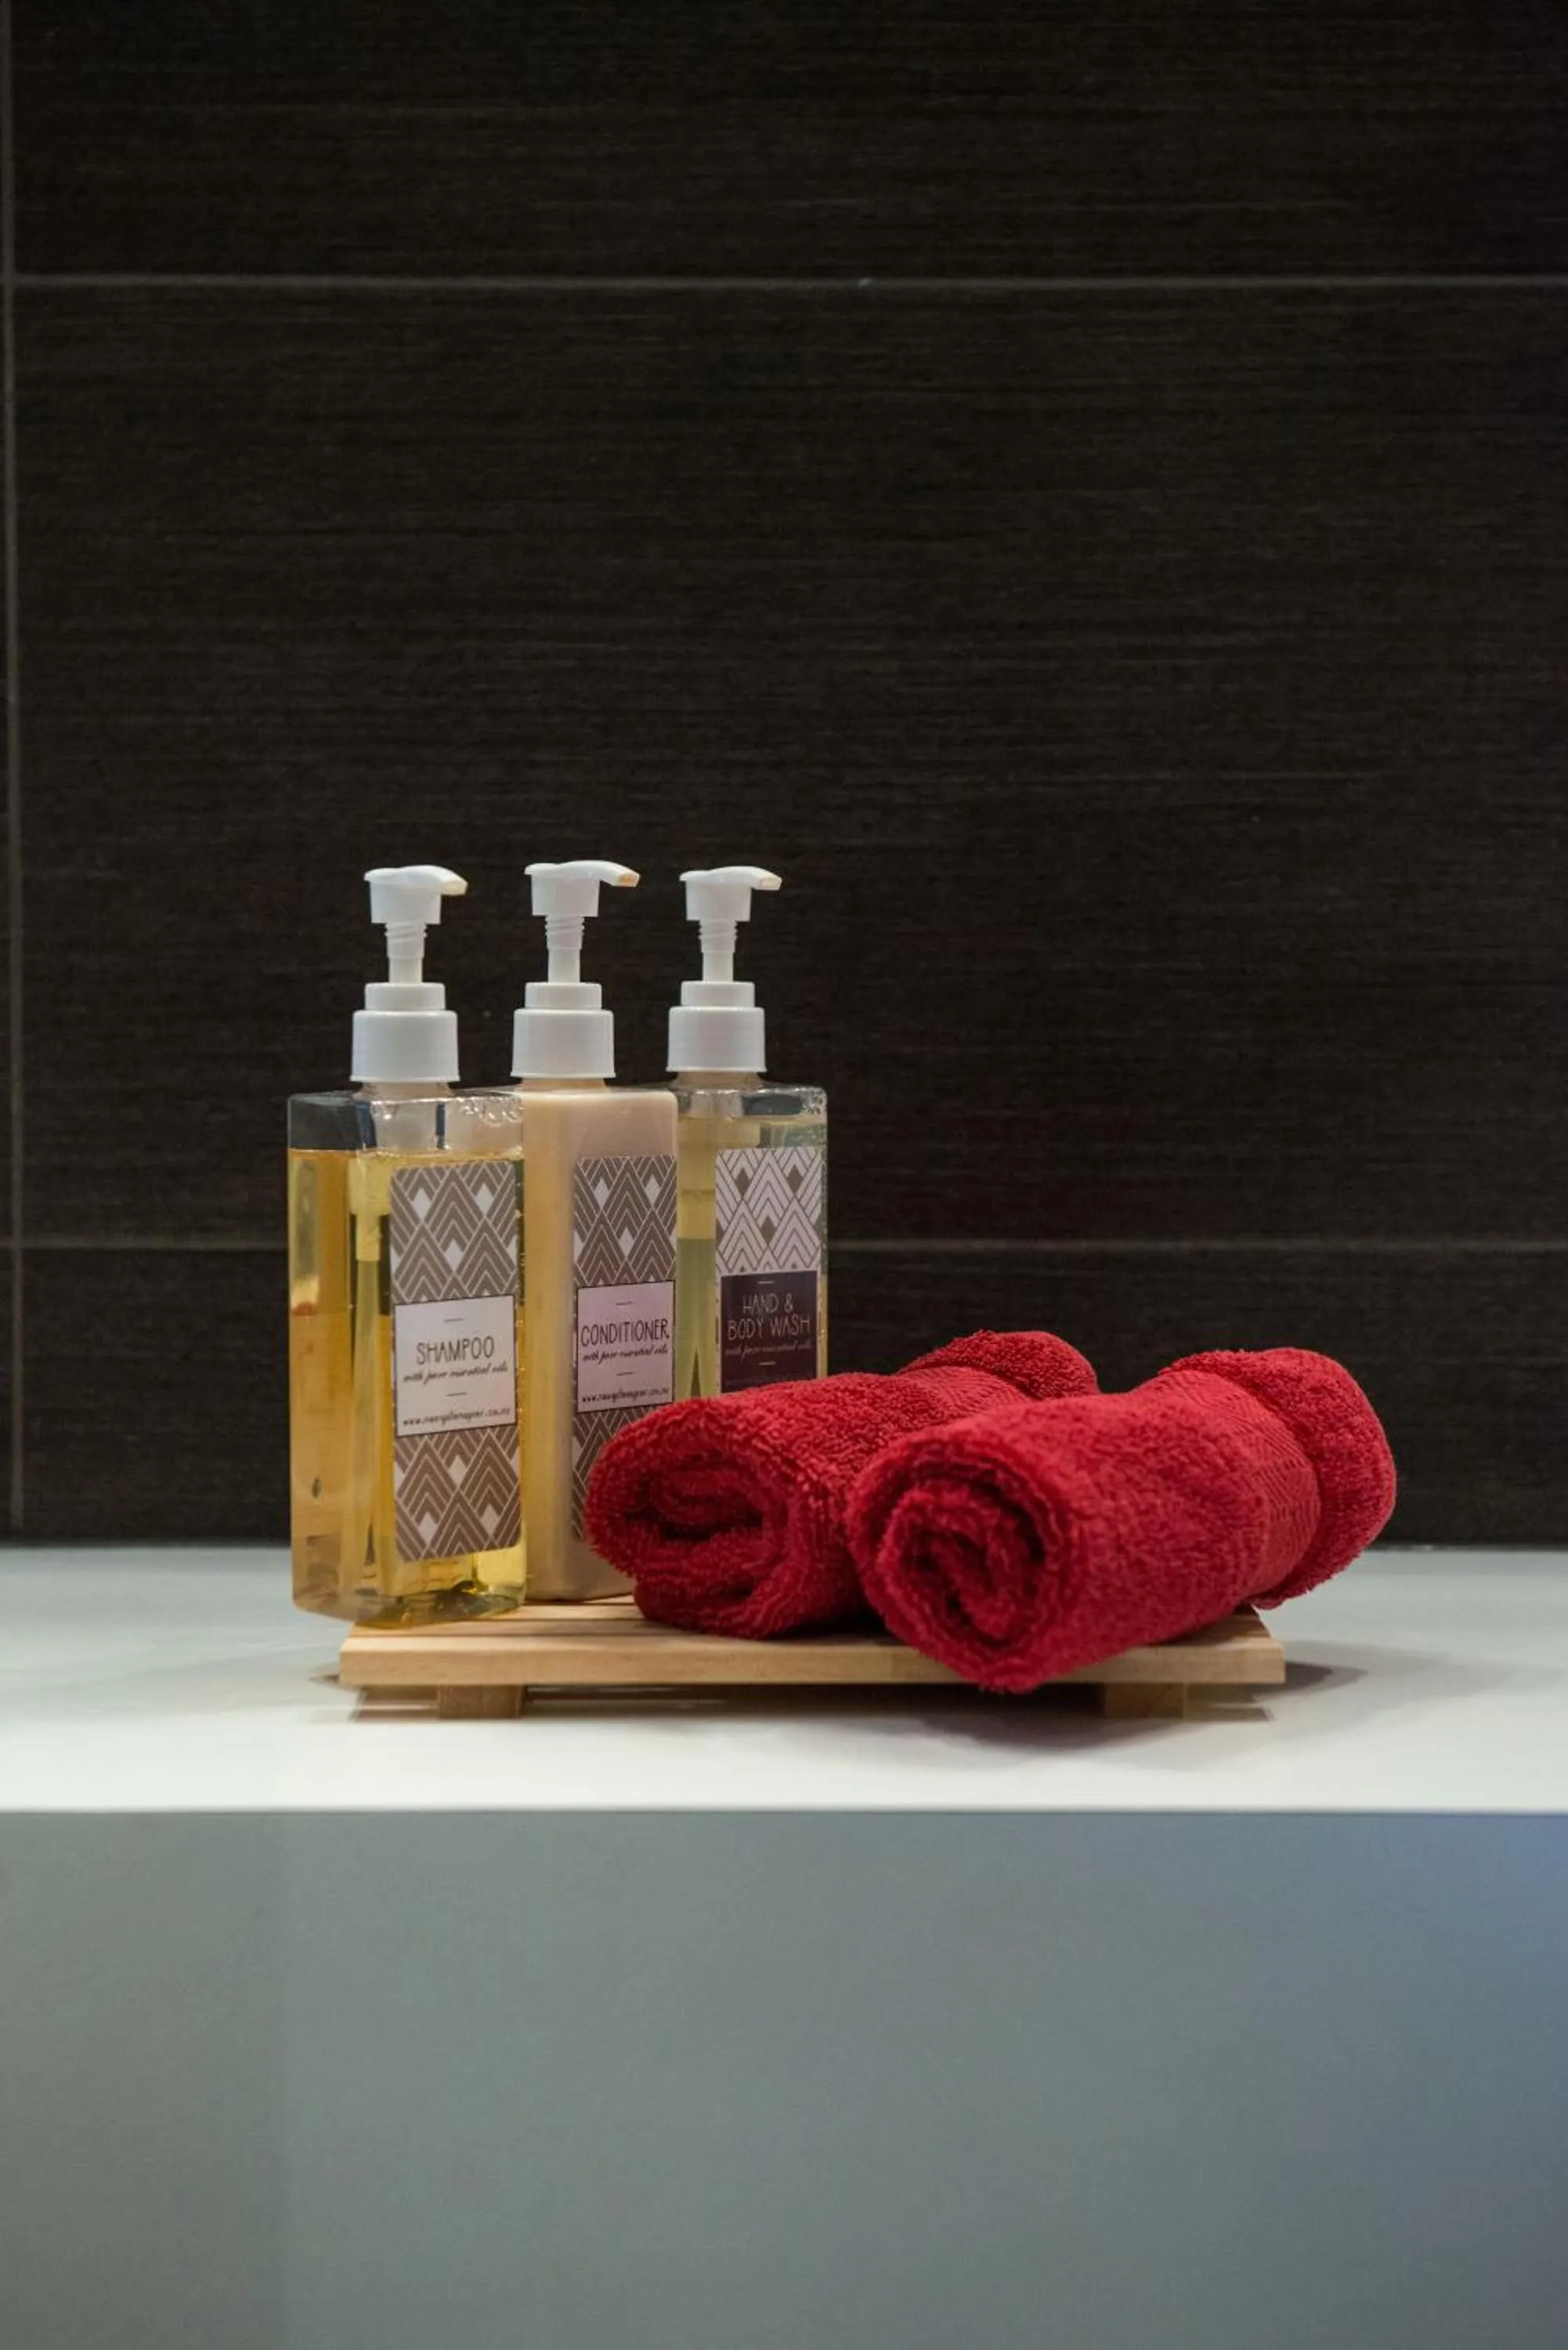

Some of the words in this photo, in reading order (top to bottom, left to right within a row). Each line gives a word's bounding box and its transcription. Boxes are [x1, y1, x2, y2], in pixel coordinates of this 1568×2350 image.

[742, 1292, 779, 1314] HAND
[784, 1292, 793, 1314] &
[728, 1318, 764, 1340] BODY
[770, 1314, 811, 1336] WASH
[416, 1336, 494, 1365] SHAMPOO
